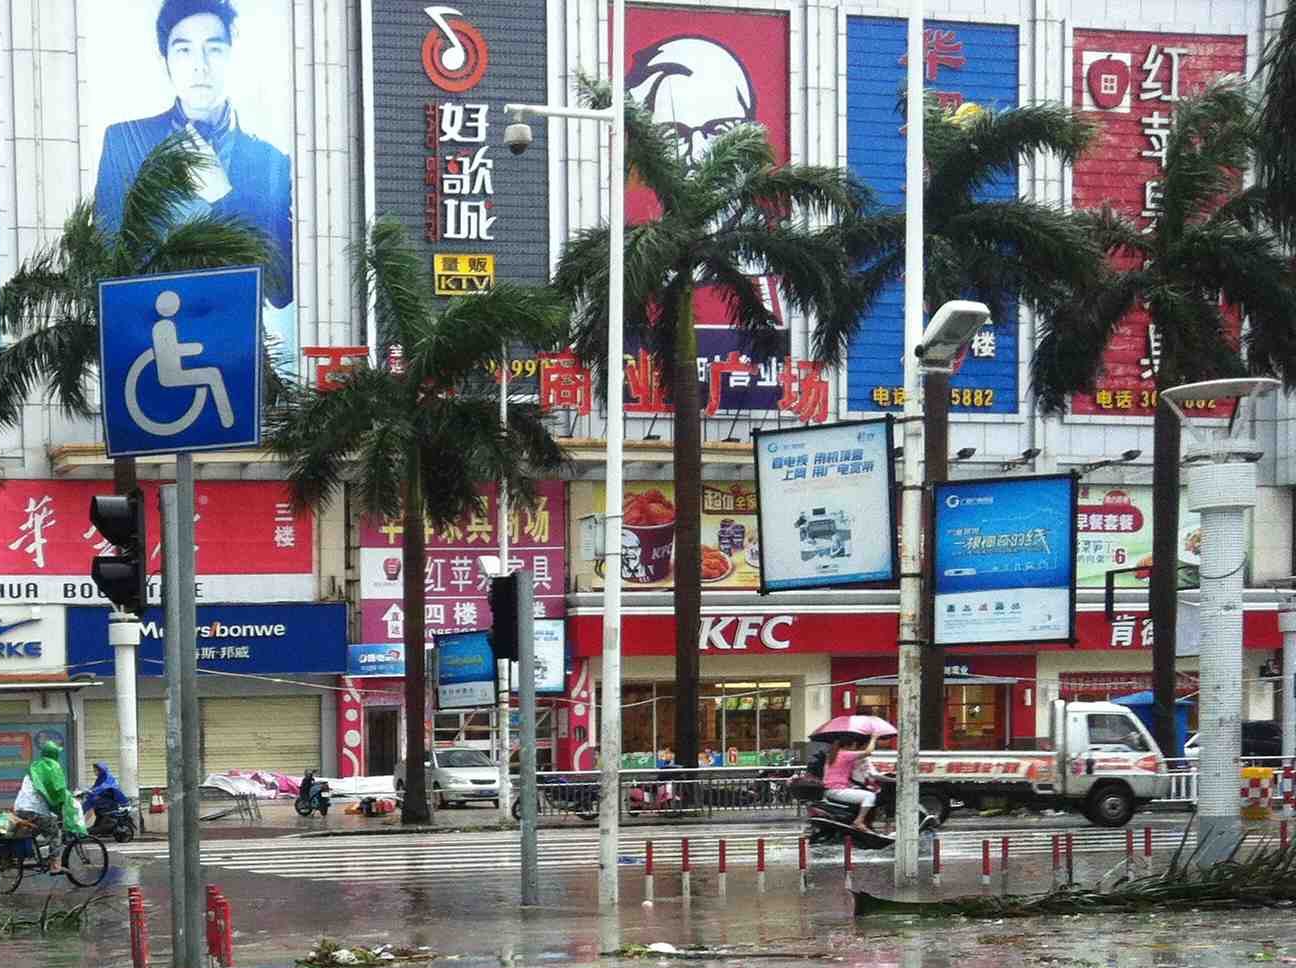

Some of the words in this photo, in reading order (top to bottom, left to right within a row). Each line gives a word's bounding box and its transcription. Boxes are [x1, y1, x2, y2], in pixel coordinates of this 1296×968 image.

[439, 102, 497, 240] 好歌城
[440, 276, 489, 290] KTV
[1097, 389, 1133, 409] 电话
[275, 503, 296, 549] 三楼
[698, 615, 794, 650] KFC
